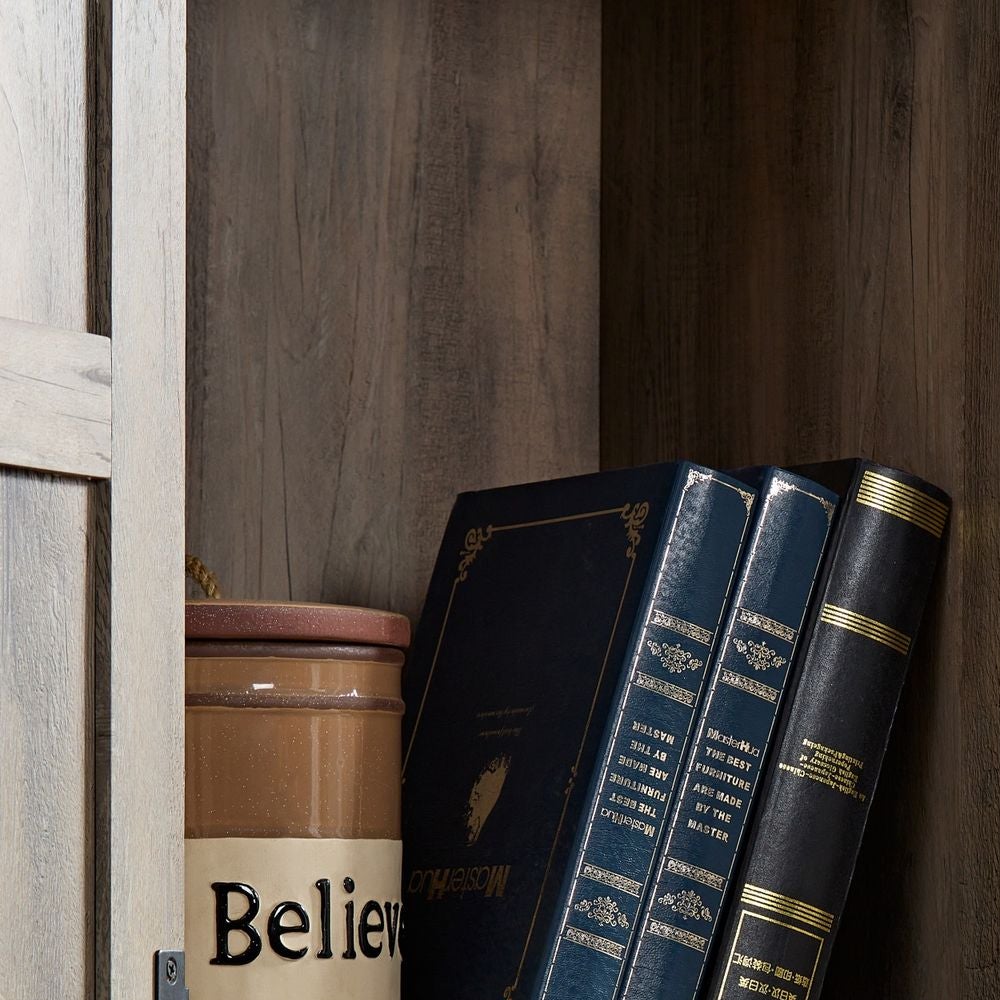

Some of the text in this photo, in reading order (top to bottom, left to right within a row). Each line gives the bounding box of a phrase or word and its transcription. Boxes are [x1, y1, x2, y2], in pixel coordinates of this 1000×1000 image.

[632, 721, 675, 745] MASTER
[706, 728, 760, 758] MasterHua
[630, 740, 667, 762] BY THE
[705, 746, 752, 772] THE BEST
[618, 755, 669, 781] ARE MADE
[695, 762, 751, 791] FURNITURE
[810, 757, 836, 772] Glossary
[609, 773, 667, 802] FURNITURE
[692, 783, 743, 809] ARE MADE
[609, 793, 657, 818] THE BEST
[696, 802, 731, 823] BY THE
[687, 819, 729, 842] MASTER
[209, 876, 404, 966] Believ
